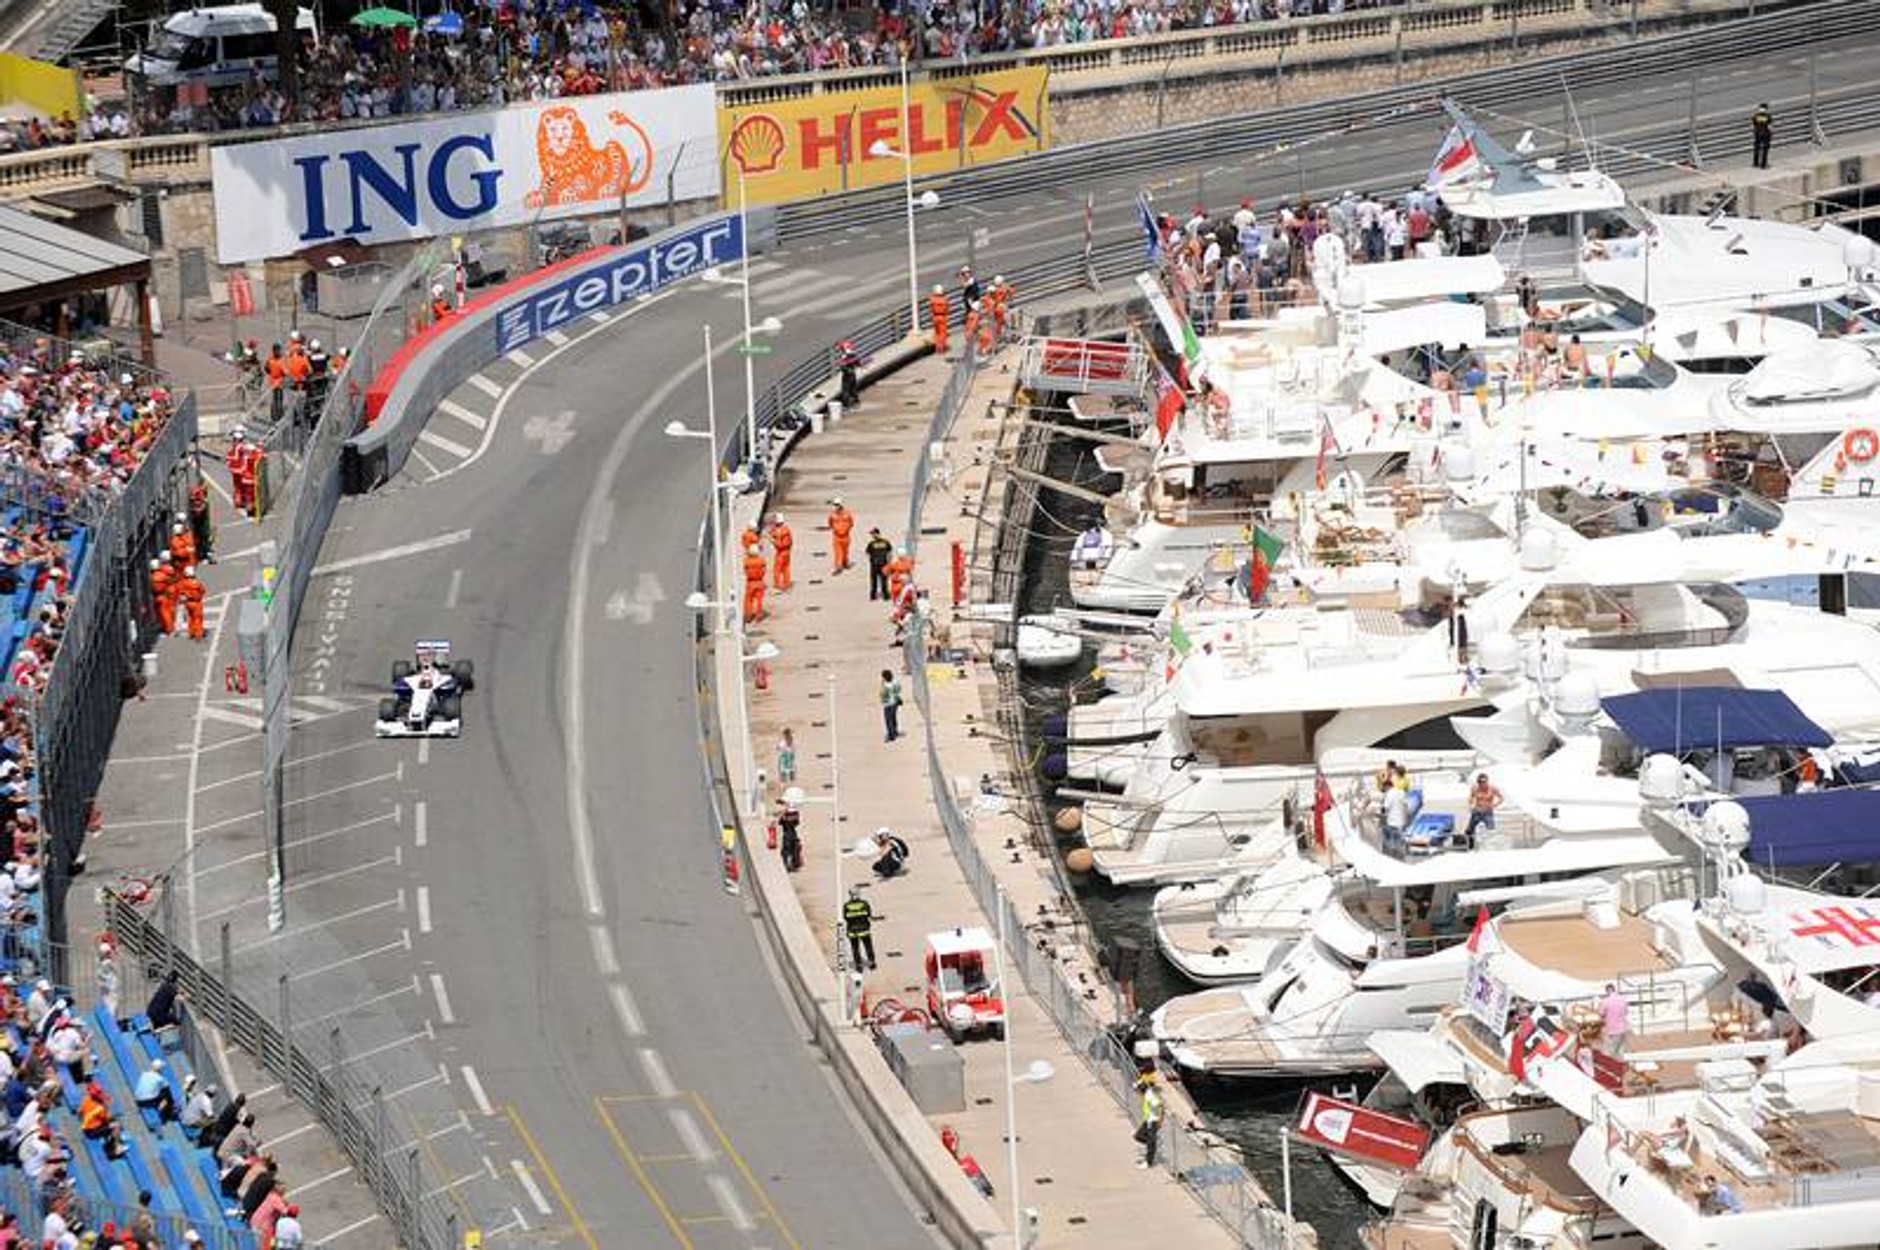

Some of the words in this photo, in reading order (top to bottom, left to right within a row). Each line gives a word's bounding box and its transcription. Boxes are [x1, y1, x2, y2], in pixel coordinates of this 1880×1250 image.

[799, 88, 1031, 170] HELIX
[294, 134, 503, 241] ING
[544, 226, 731, 326] zepter
